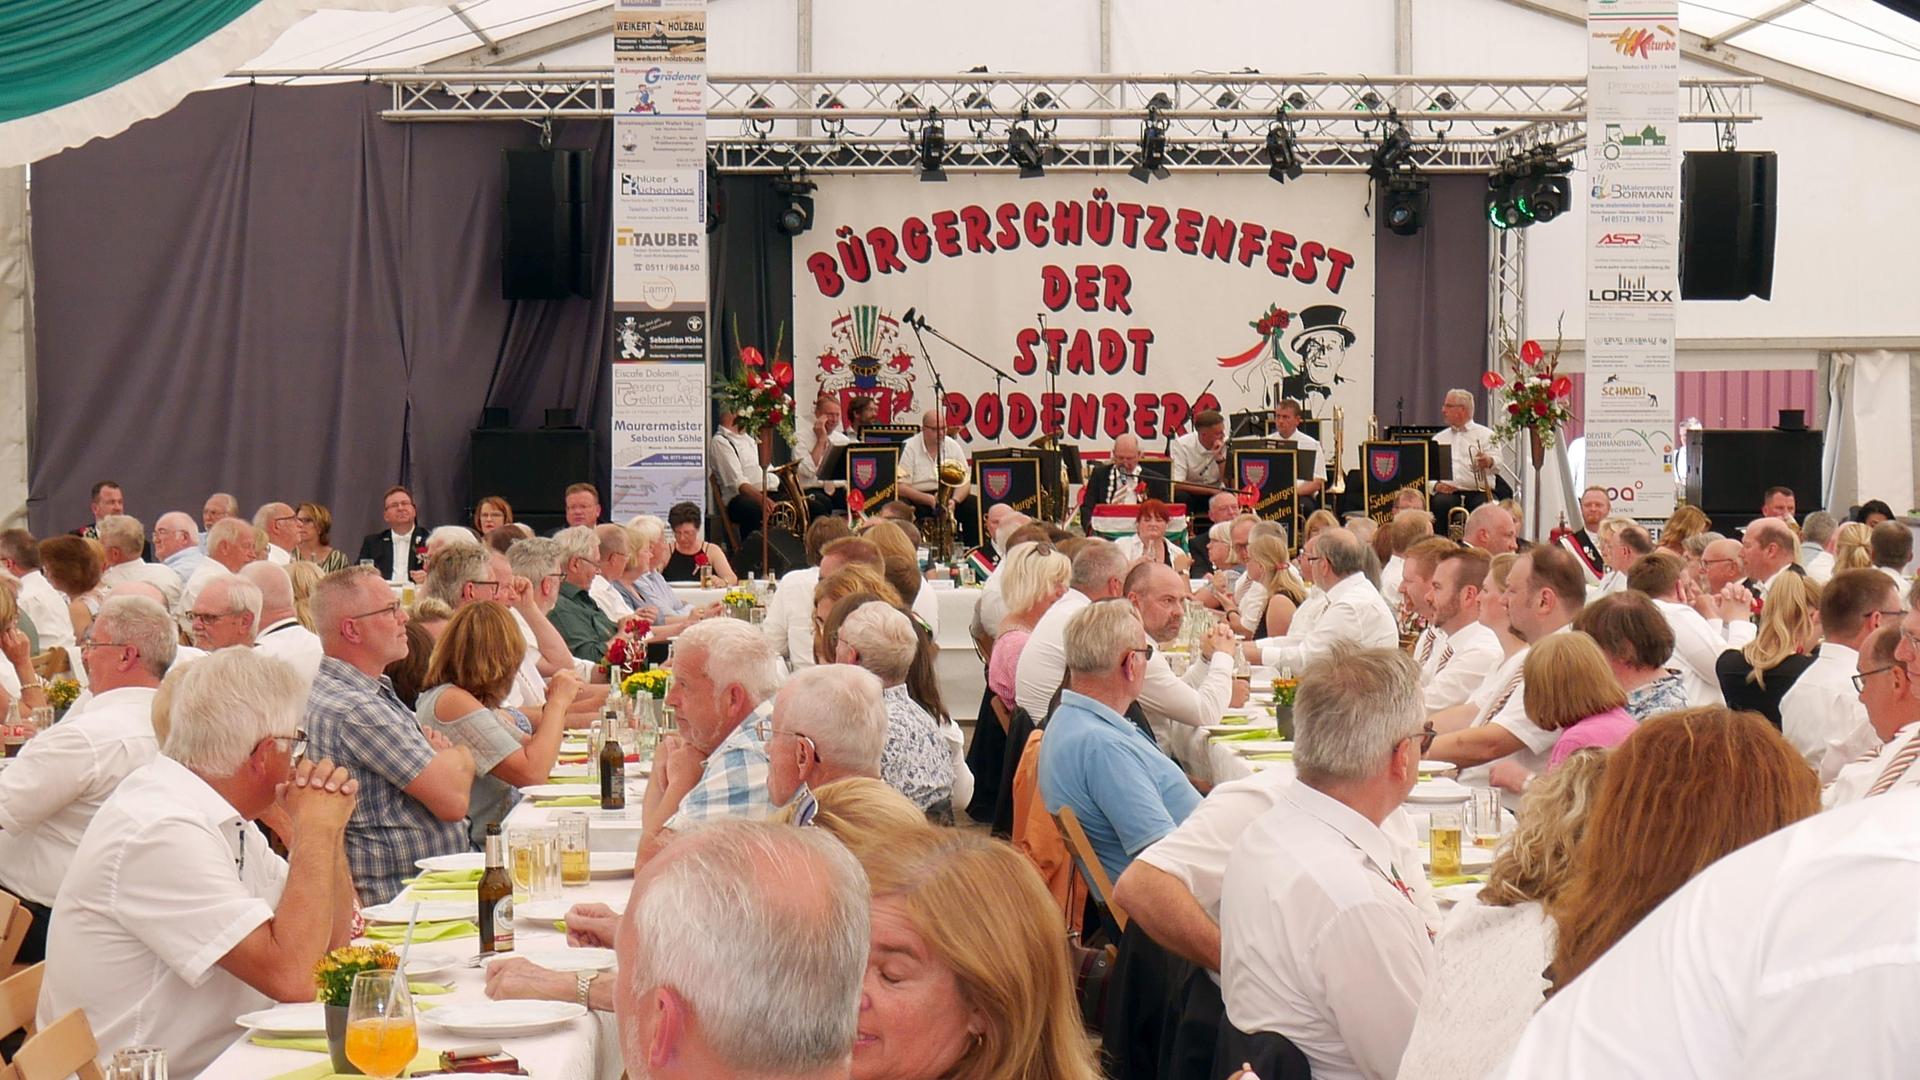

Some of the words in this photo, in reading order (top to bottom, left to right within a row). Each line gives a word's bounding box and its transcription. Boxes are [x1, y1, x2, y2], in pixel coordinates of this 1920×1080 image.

[617, 22, 651, 31] WEIKERT
[668, 22, 704, 31] HOLZBAU
[645, 67, 701, 85] Grädener
[1611, 184, 1673, 199] BORMANN
[633, 233, 698, 246] TAUBER
[806, 187, 1355, 298] BÜRGERSCHÜTZENFEST
[1598, 234, 1641, 244] ASR
[643, 285, 673, 293] Lamm
[1041, 263, 1132, 315] DER
[1589, 289, 1673, 302] LOREXX
[1013, 327, 1155, 376] STADT
[615, 420, 702, 431] Maurermeister
[631, 434, 675, 442] Sebastian
[678, 434, 702, 442] Söhle
